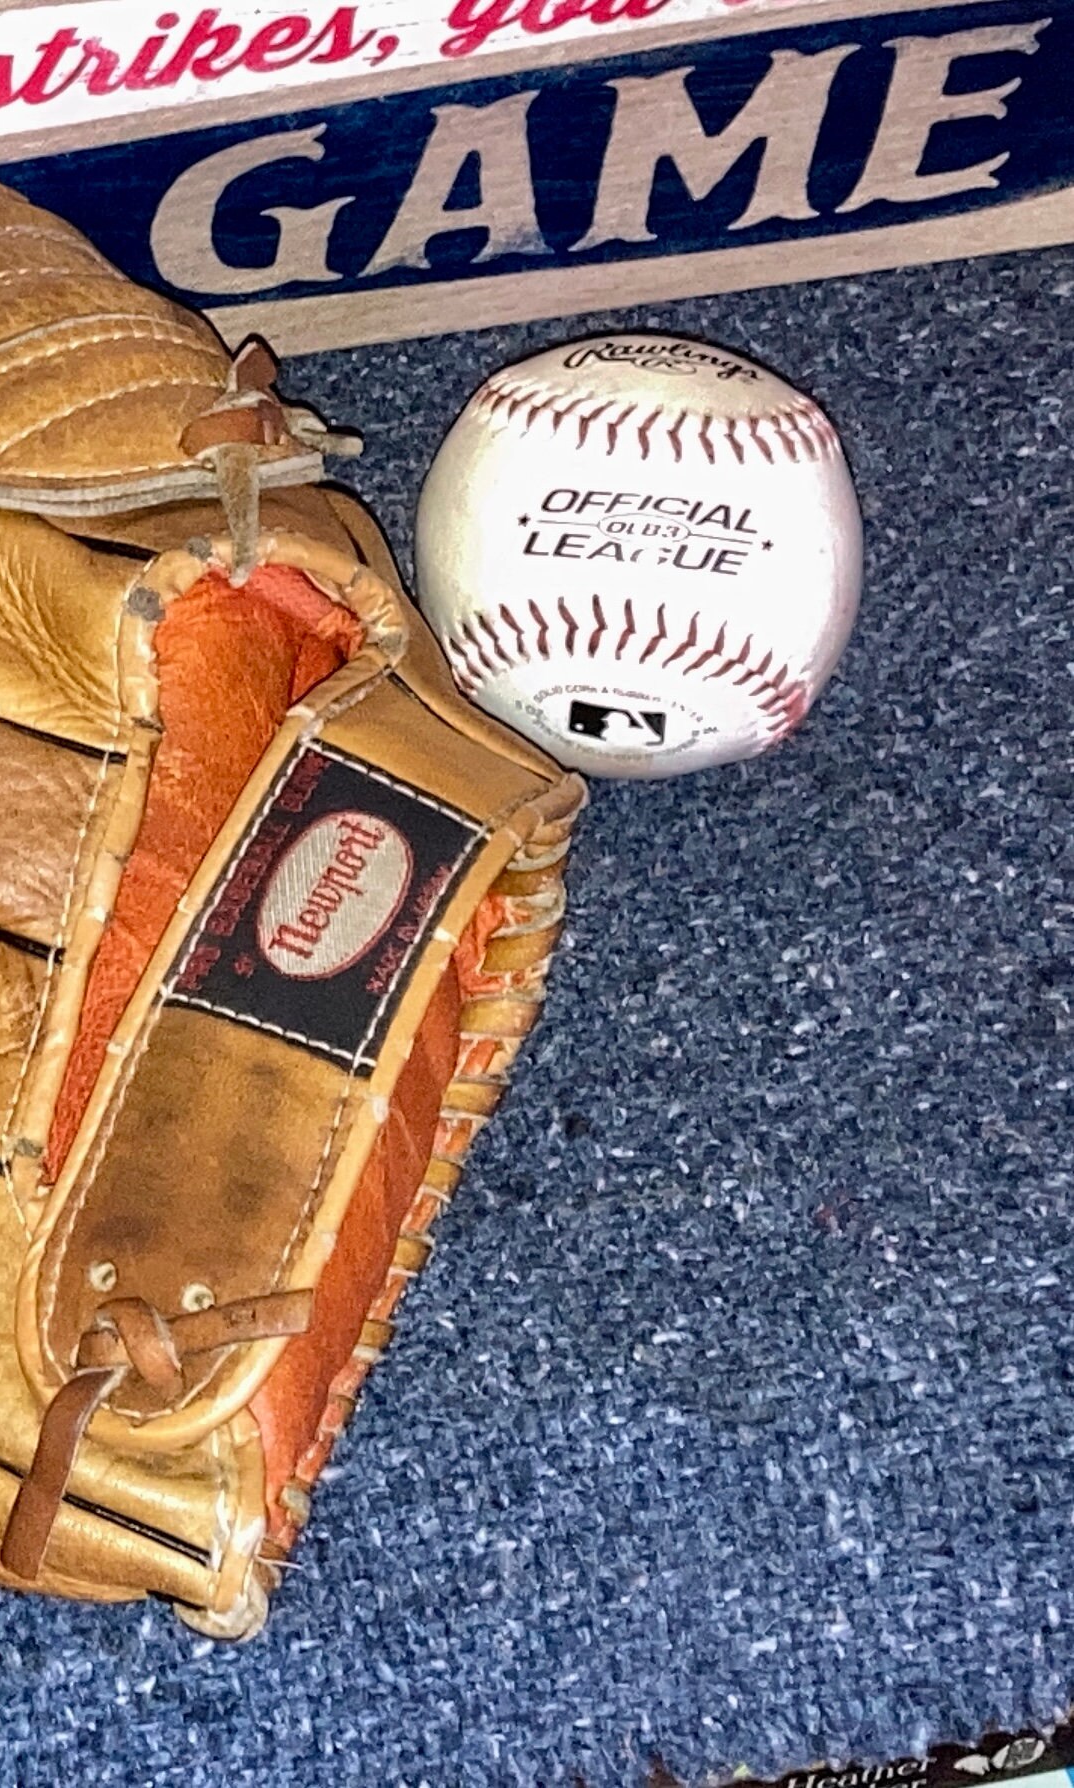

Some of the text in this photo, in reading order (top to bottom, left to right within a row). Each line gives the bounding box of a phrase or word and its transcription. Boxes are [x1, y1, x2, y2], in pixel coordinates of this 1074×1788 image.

[150, 18, 1052, 294] GAME
[563, 342, 764, 380] Rawlings
[540, 488, 757, 534] OFFICIAL
[268, 819, 385, 959] Newport
